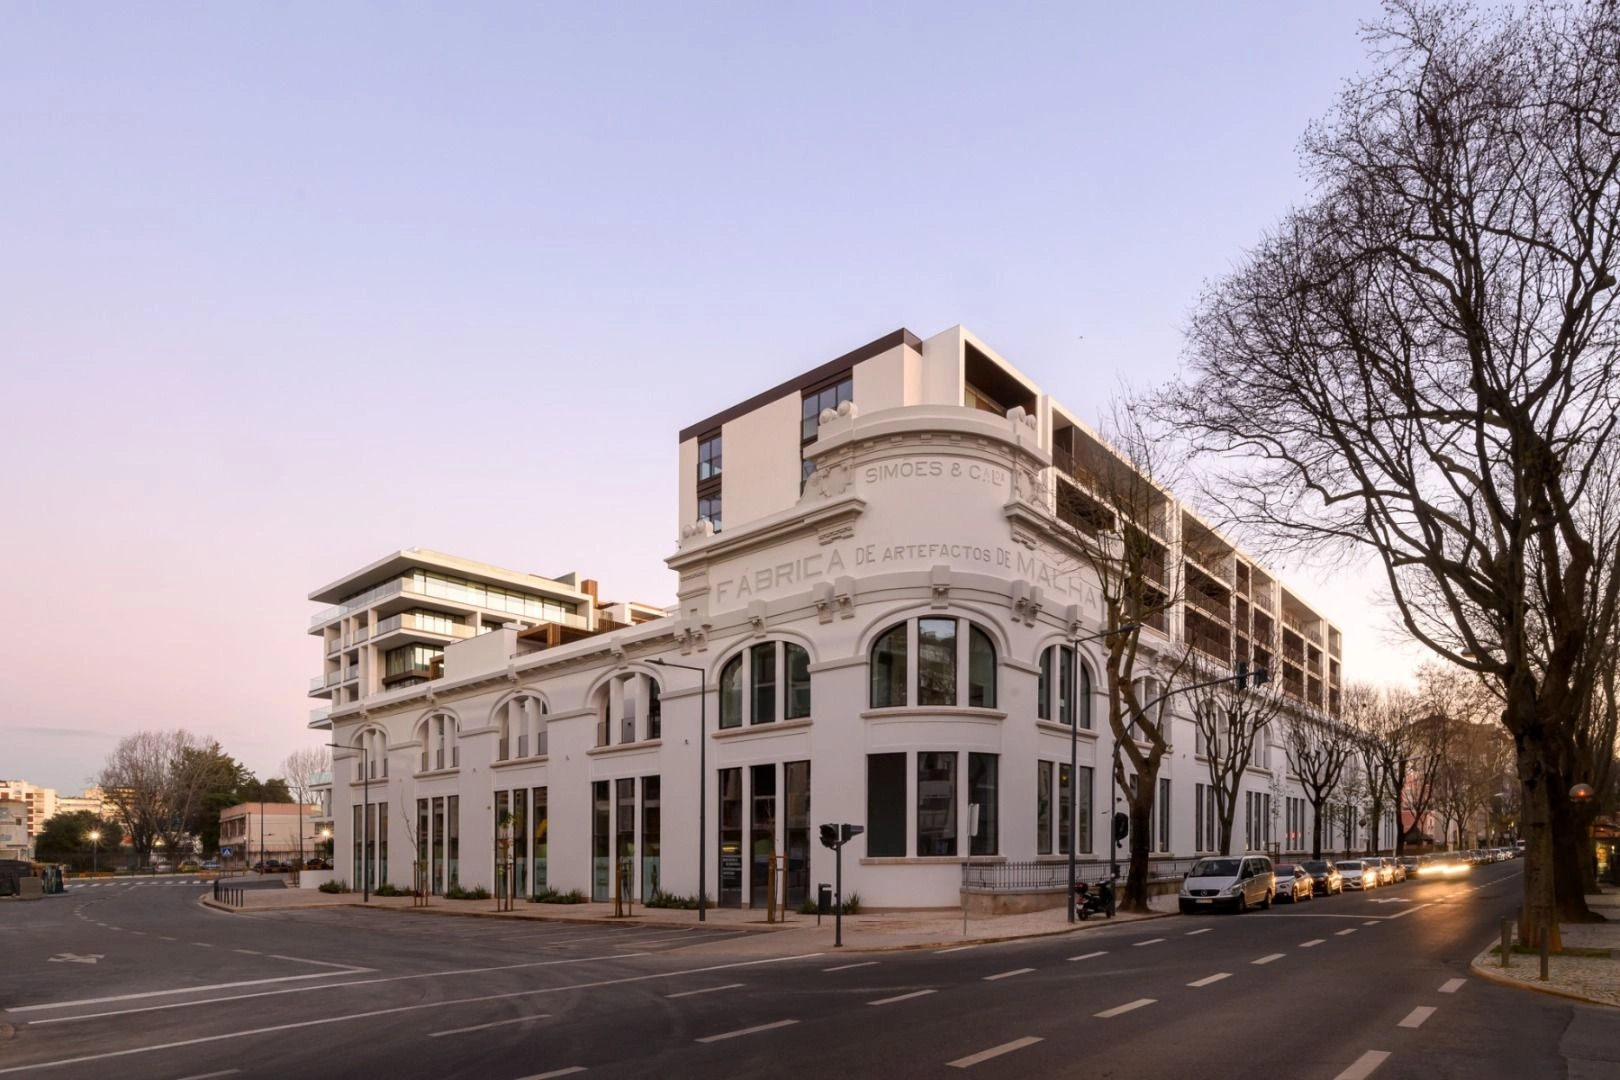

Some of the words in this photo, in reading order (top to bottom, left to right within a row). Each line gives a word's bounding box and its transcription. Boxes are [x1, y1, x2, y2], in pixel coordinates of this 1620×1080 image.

[951, 462, 962, 477] &
[855, 544, 876, 566] DE
[882, 543, 992, 563] ARTEFACTOS
[996, 546, 1012, 569] DE
